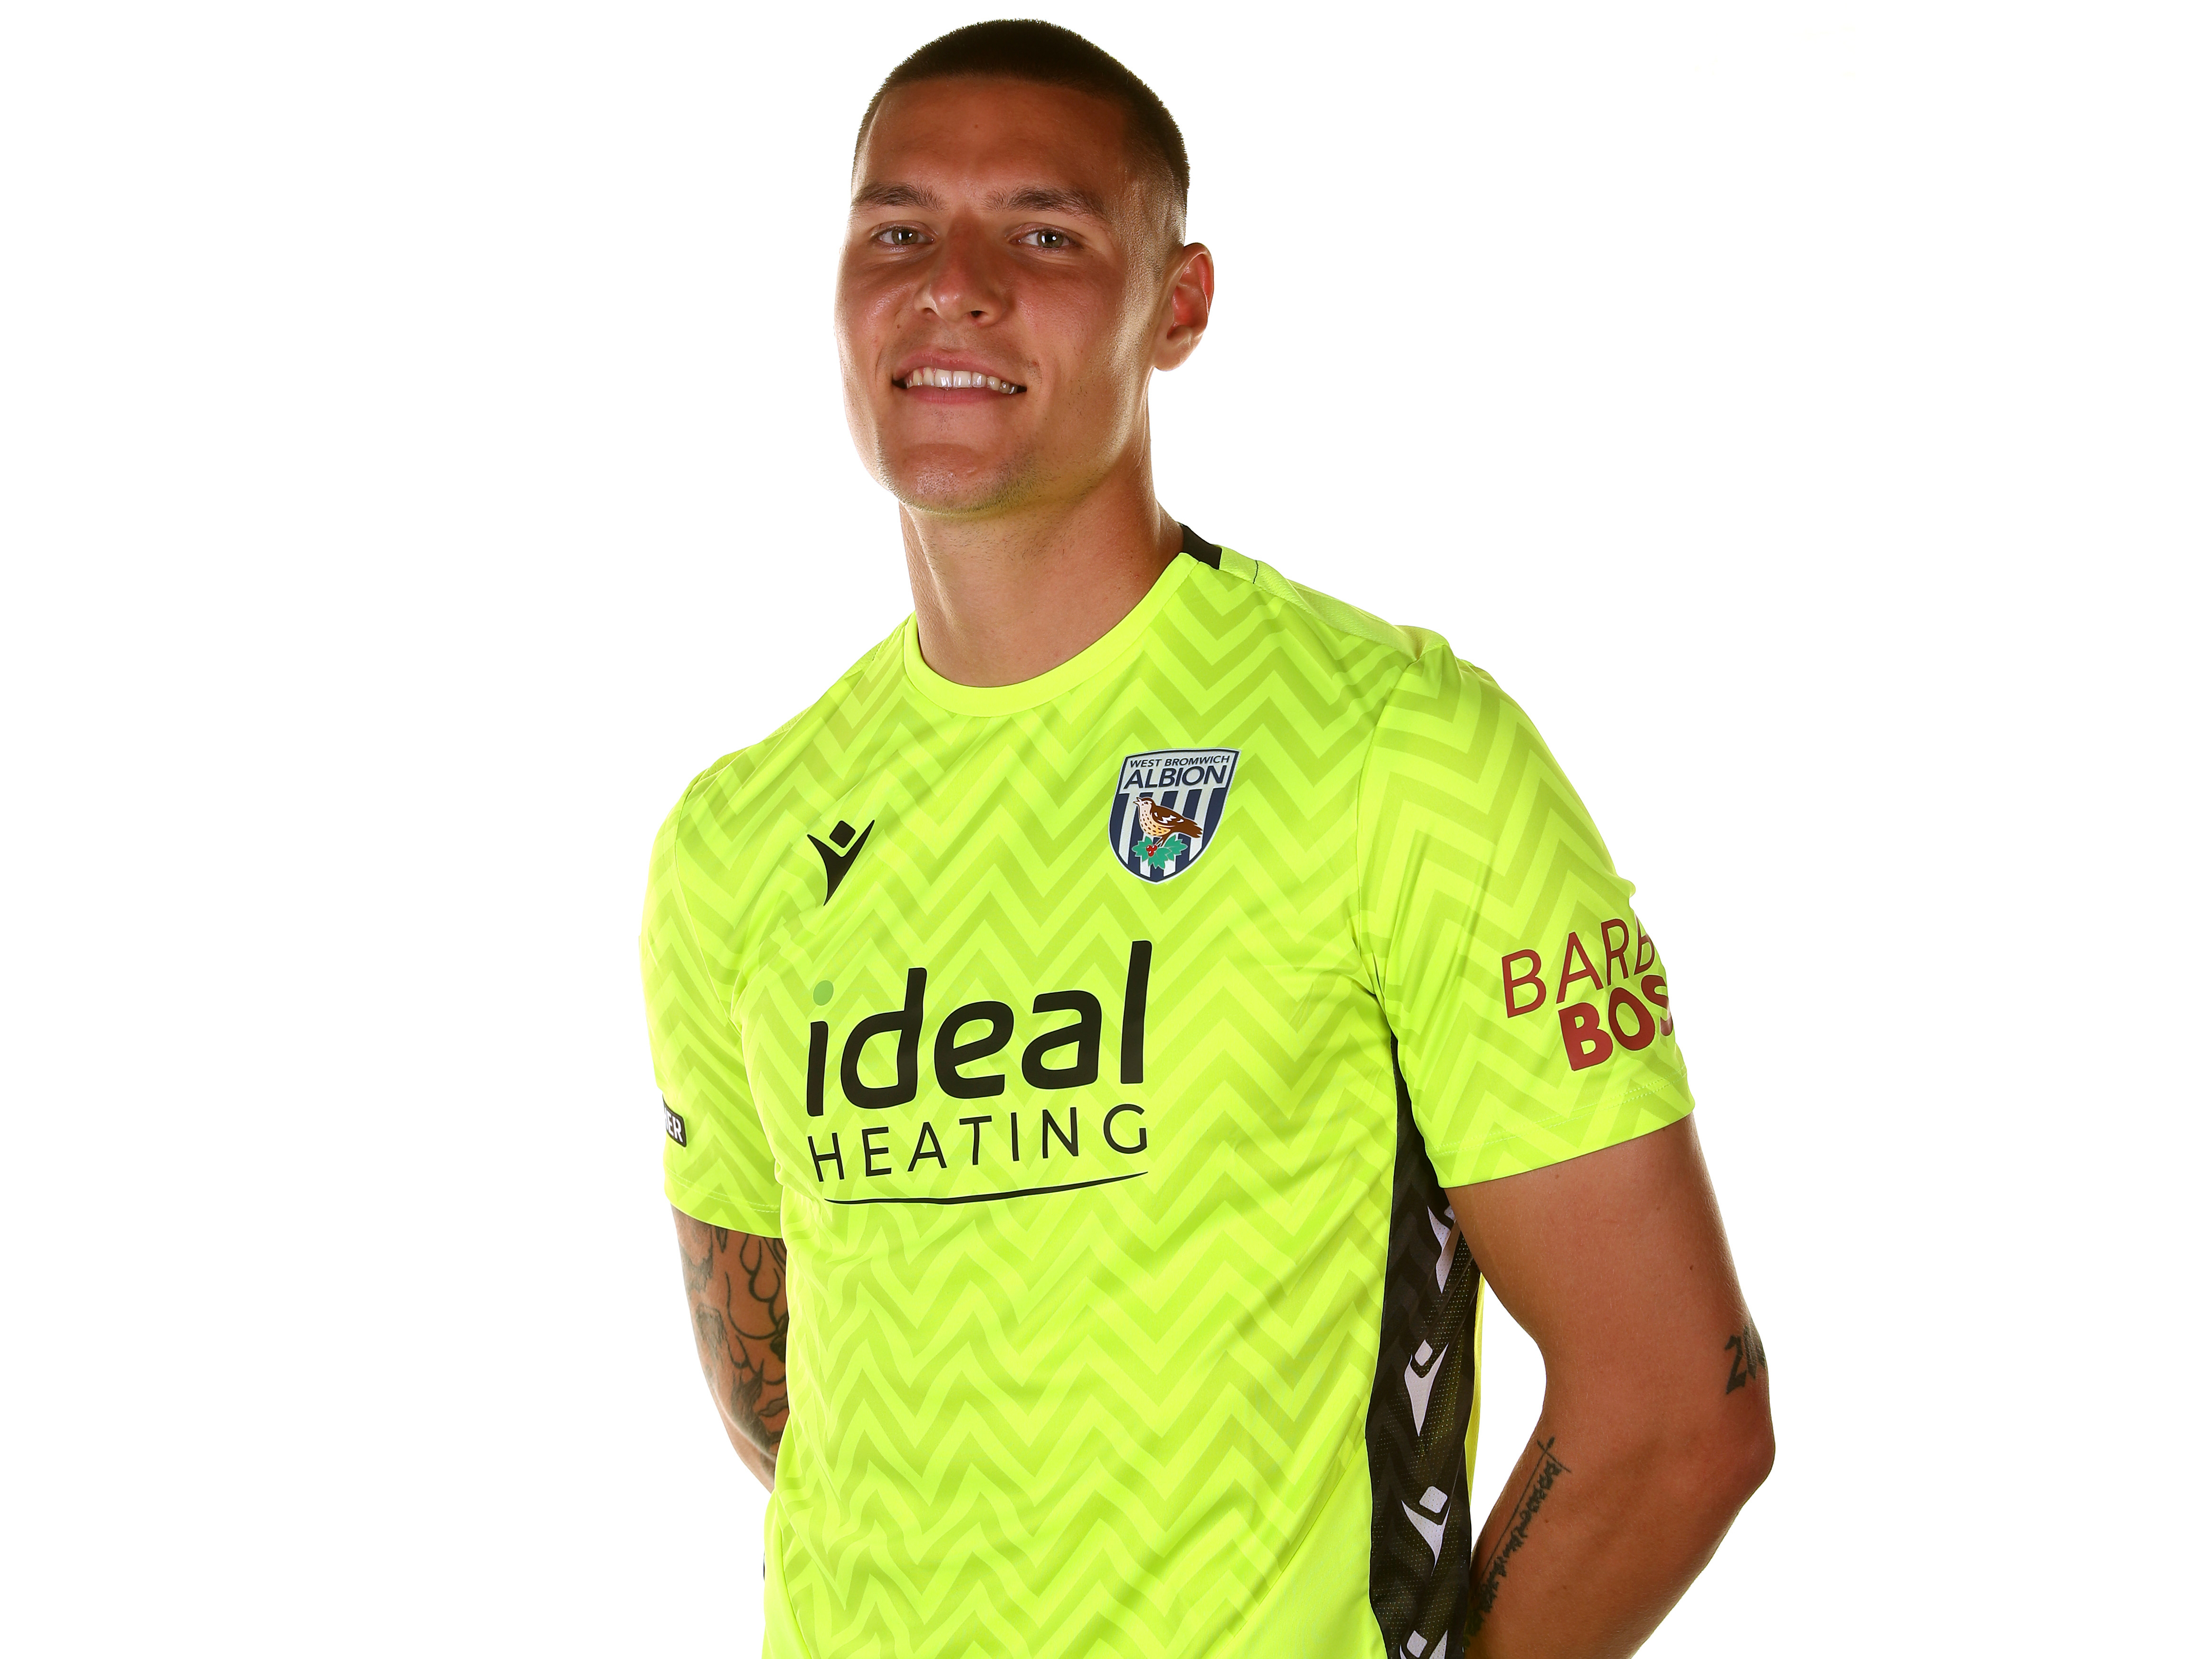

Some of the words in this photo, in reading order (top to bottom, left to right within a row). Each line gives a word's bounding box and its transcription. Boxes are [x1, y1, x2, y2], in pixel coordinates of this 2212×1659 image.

[1124, 765, 1227, 789] ALBION
[1130, 758, 1162, 768] WEST
[1164, 755, 1230, 766] BROMWICH
[806, 940, 1152, 1117] ideal
[808, 1104, 1148, 1182] HEATING
